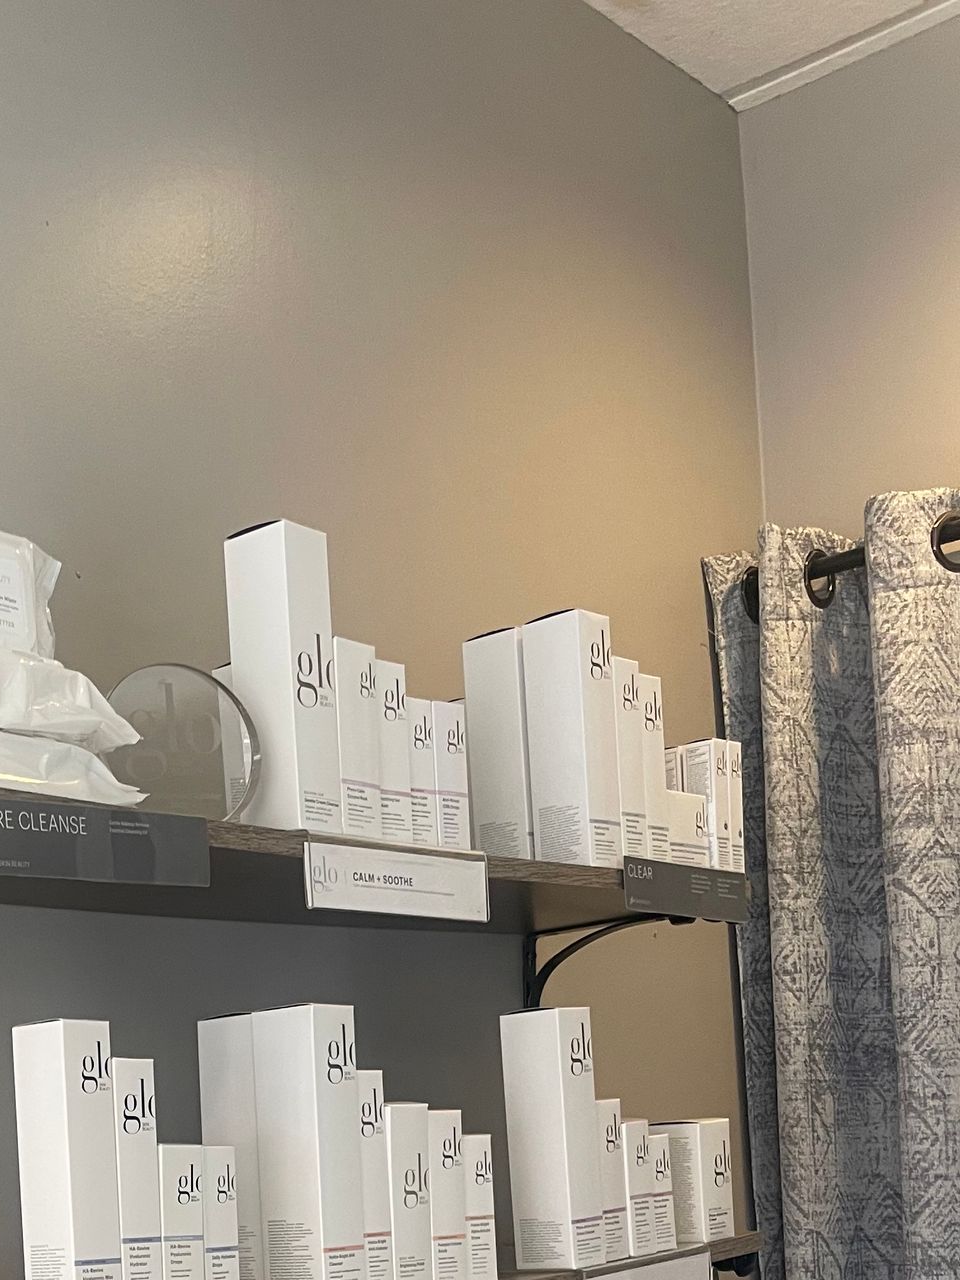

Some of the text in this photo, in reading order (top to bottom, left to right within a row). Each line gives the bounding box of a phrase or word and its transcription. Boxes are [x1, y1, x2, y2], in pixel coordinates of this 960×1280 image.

[731, 753, 742, 778] gl
[18, 810, 88, 835] CLEANSE
[695, 802, 709, 838] gl
[313, 855, 338, 894] glo
[352, 871, 376, 884] CALM
[383, 874, 414, 887] SOOTHE
[627, 863, 654, 880] CLEAR
